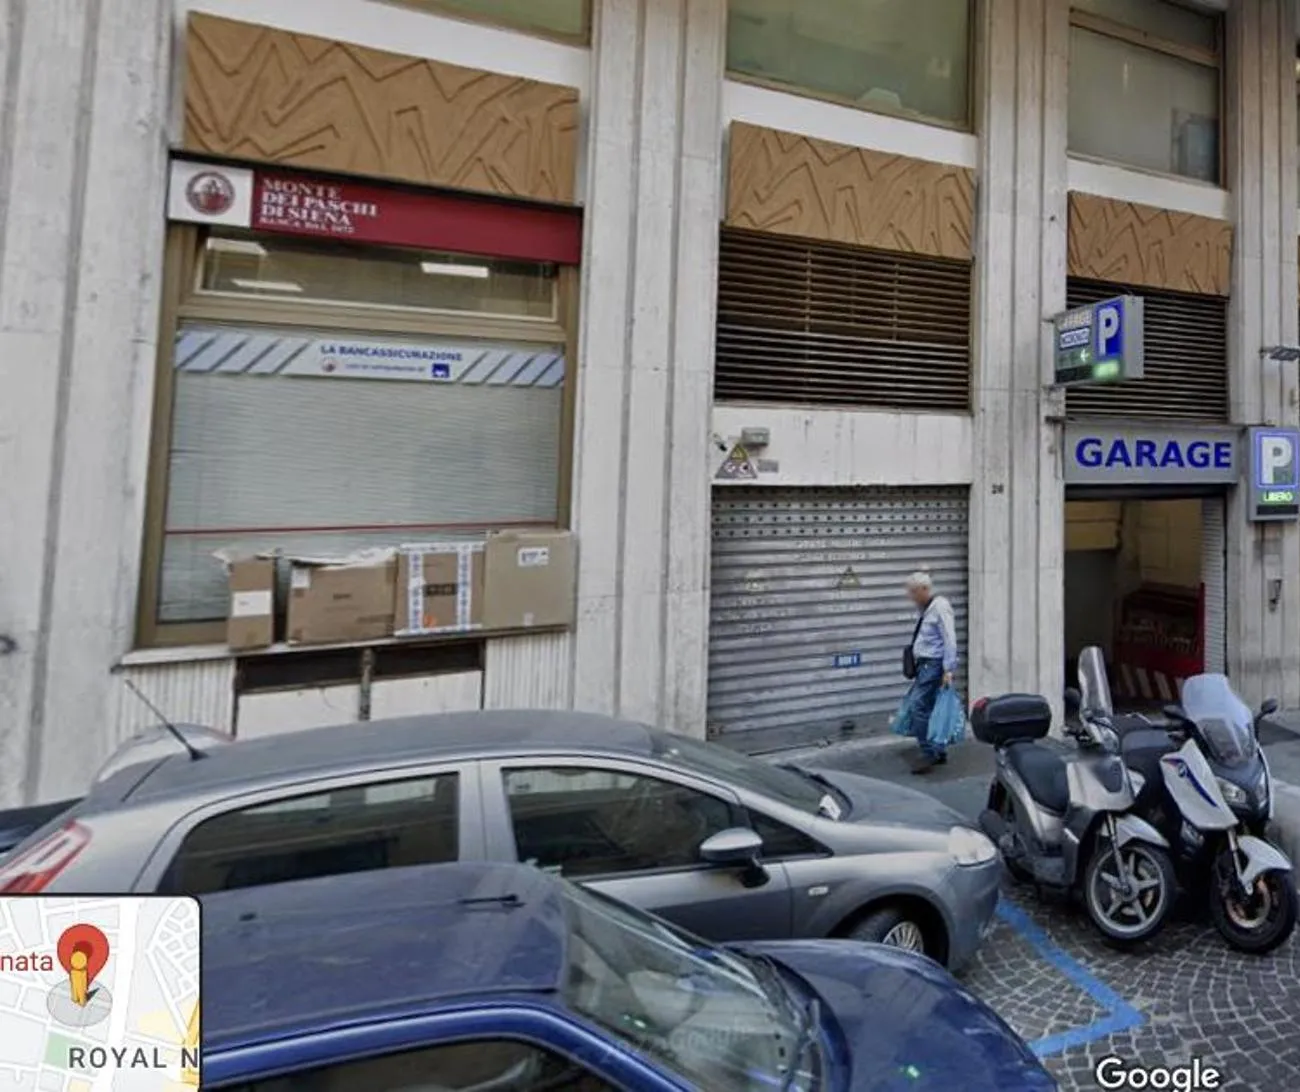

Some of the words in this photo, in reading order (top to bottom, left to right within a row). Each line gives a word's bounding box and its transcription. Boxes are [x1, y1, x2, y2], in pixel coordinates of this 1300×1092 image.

[263, 178, 340, 200] MONTE
[262, 191, 299, 207] DEI
[303, 196, 378, 217] PASCHI
[262, 204, 285, 217] DI
[287, 207, 351, 226] SIENA
[1098, 306, 1119, 355] P
[321, 345, 336, 354] LA
[1075, 437, 1231, 468] GARAGE
[1262, 437, 1293, 484] P
